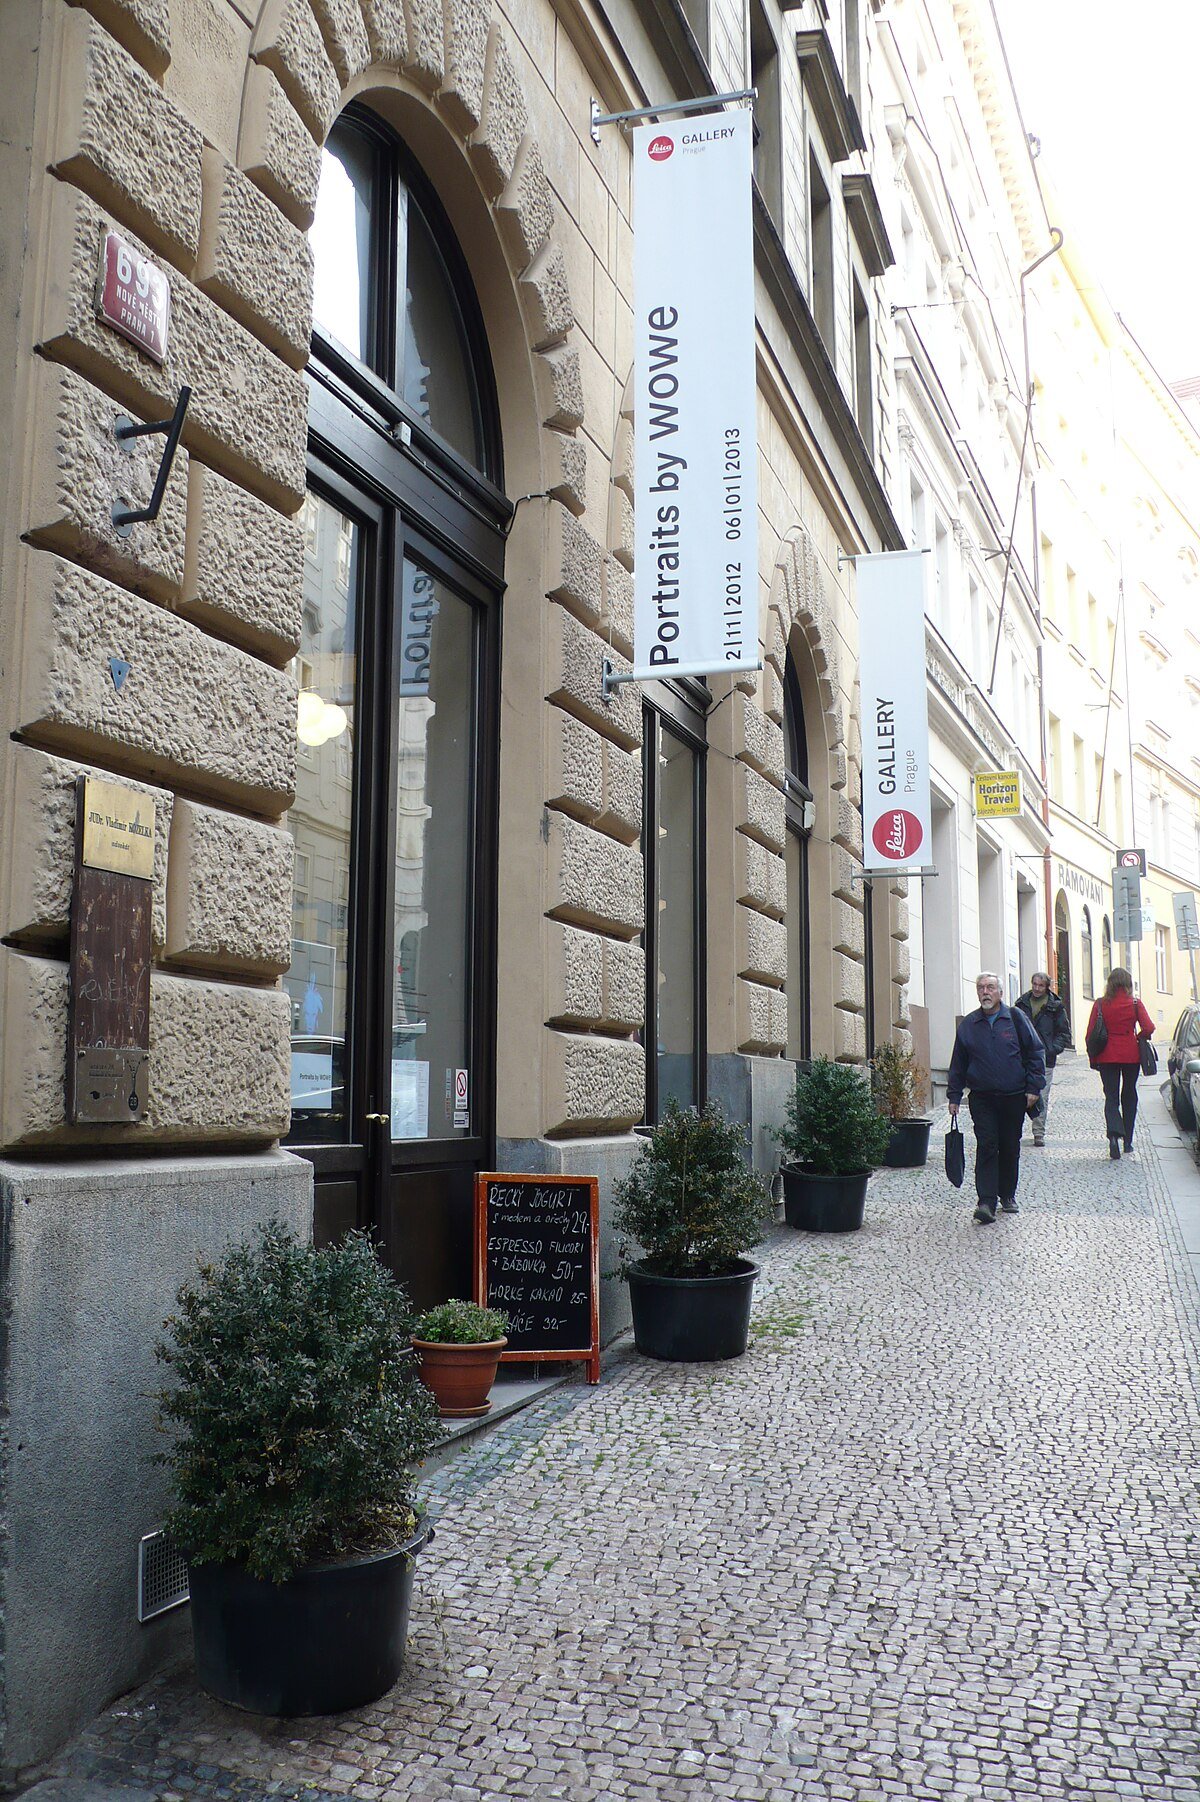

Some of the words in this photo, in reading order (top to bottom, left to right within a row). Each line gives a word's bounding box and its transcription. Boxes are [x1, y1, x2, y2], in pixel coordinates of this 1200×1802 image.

[682, 127, 735, 145] GALLERY
[649, 142, 672, 155] Leica
[682, 145, 706, 155] Prague
[116, 284, 136, 309] NOVÉ
[139, 299, 161, 330] MĚSTO
[121, 307, 146, 336] PRAHA
[150, 329, 155, 343] 1
[649, 452, 687, 493] by
[649, 505, 680, 667] Portraits
[876, 697, 896, 795] GALLERY
[904, 750, 918, 793] Prague
[979, 783, 1017, 794] Horizon
[983, 793, 1013, 805] Travel
[88, 811, 104, 826] JUDr.
[886, 812, 906, 858] Leica
[1058, 862, 1104, 906] RÁMOVÁNÍ
[489, 1184, 524, 1208] ŘECKÝ
[529, 1187, 580, 1209] JOGURT
[501, 1212, 531, 1223] medem
[534, 1214, 541, 1223] a
[545, 1211, 570, 1234] ořechy
[488, 1237, 542, 1254] ESPRESSO
[502, 1254, 546, 1273] BÁBOVKA
[489, 1278, 524, 1301] HORKÉ
[530, 1286, 564, 1302] KAKAO
